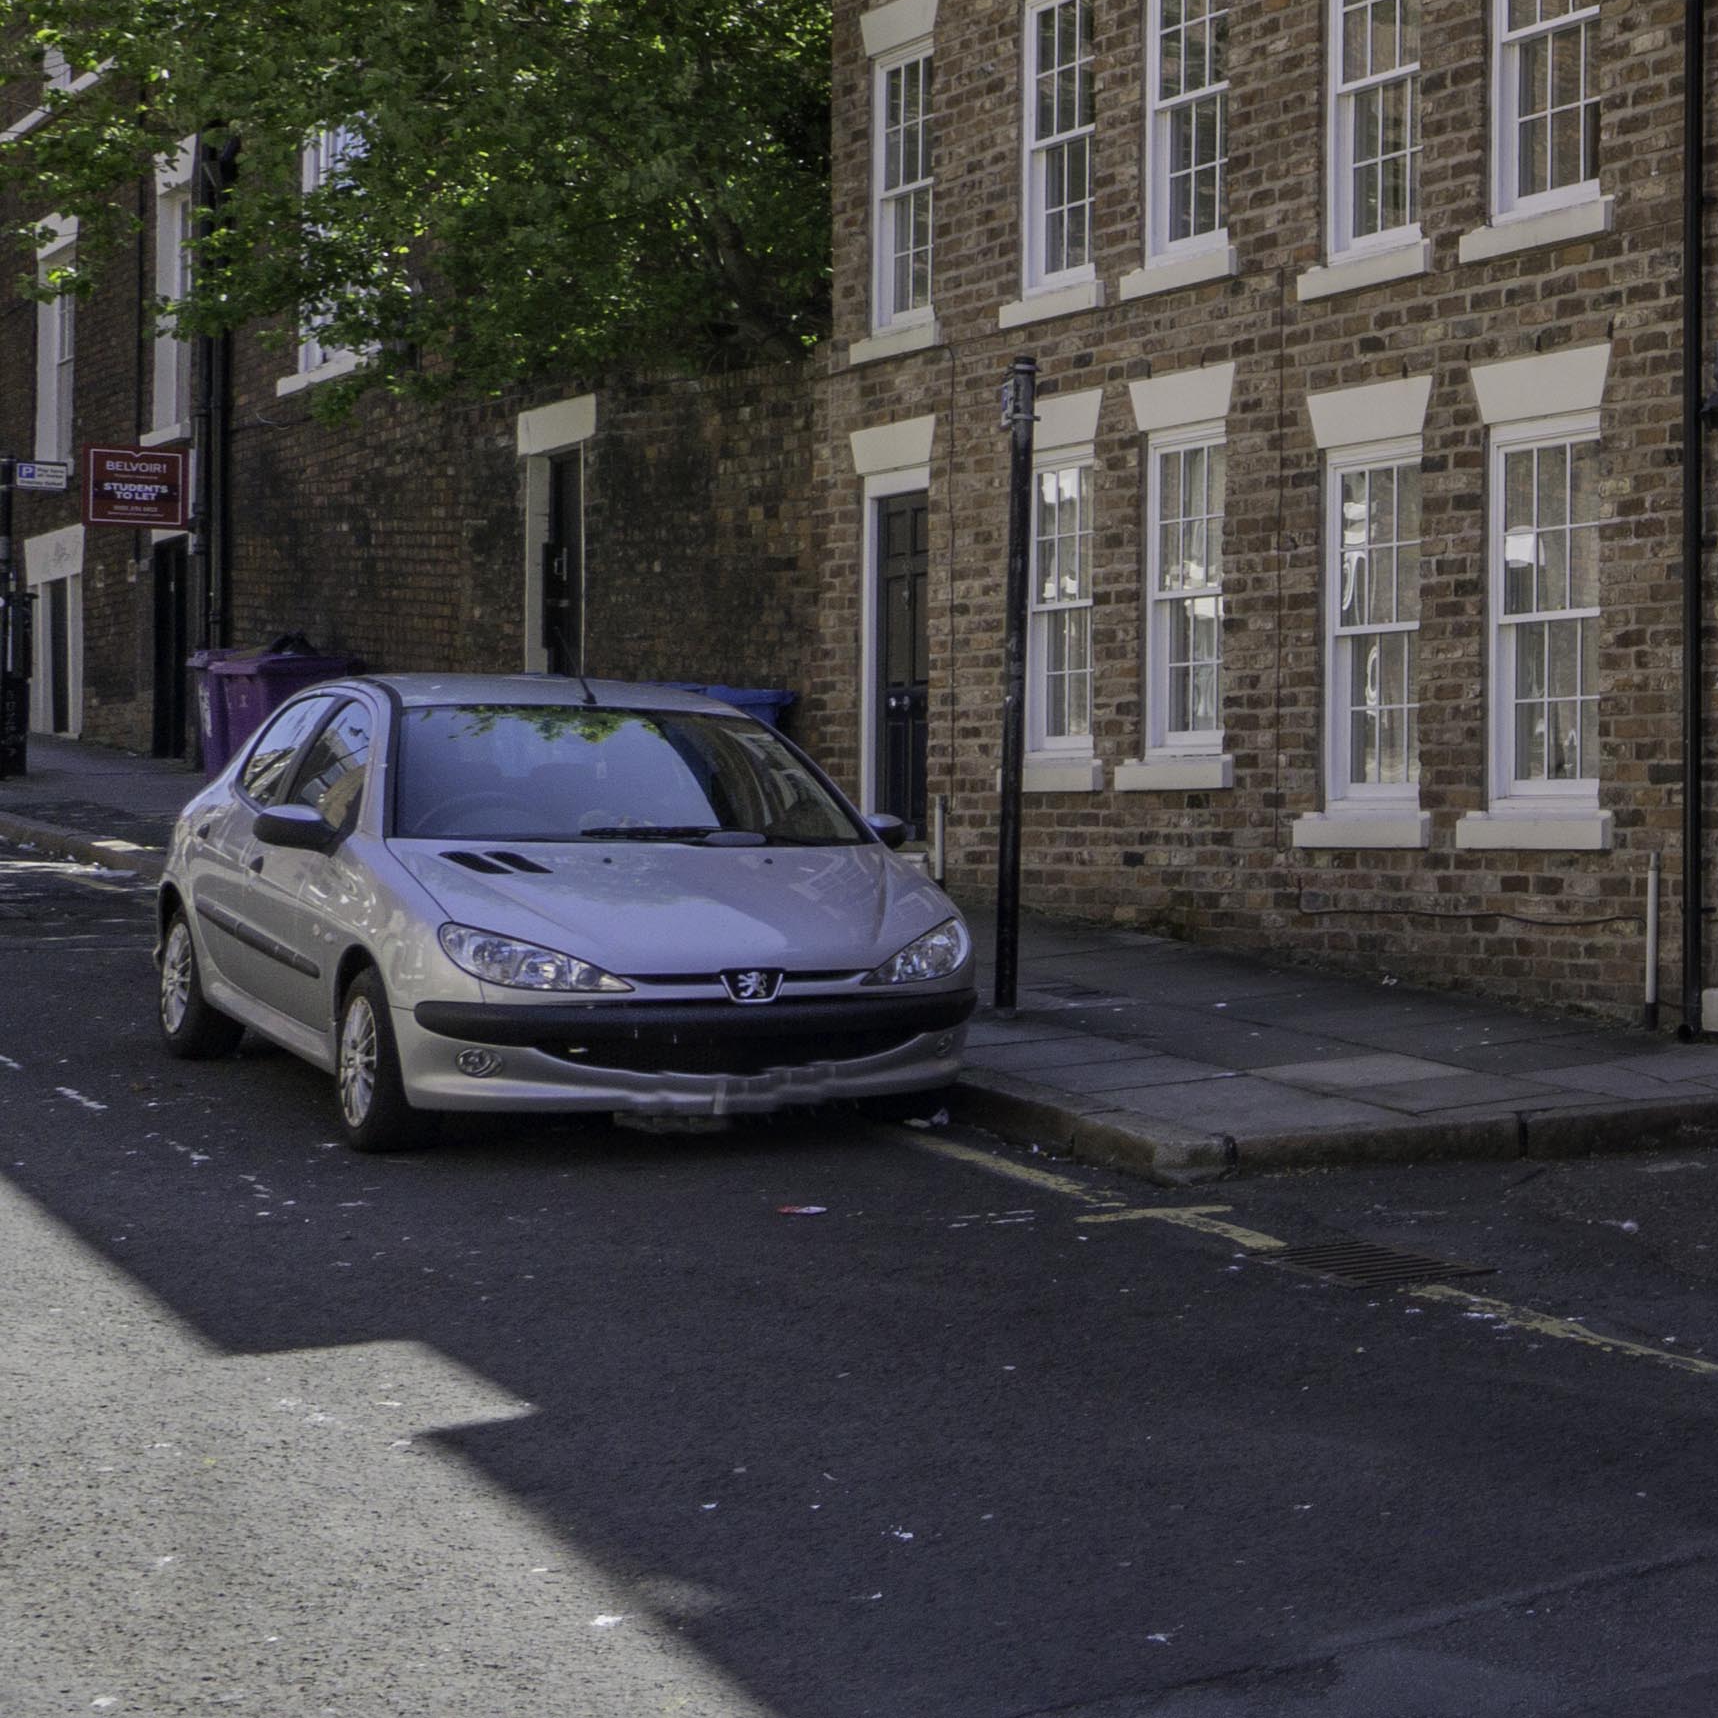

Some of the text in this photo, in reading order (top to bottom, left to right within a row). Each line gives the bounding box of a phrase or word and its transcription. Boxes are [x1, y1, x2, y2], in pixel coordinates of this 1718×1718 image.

[22, 466, 33, 477] P
[105, 460, 167, 474] BELVOIR!
[103, 482, 169, 494] STUDENTS
[115, 491, 157, 501] TO LET
